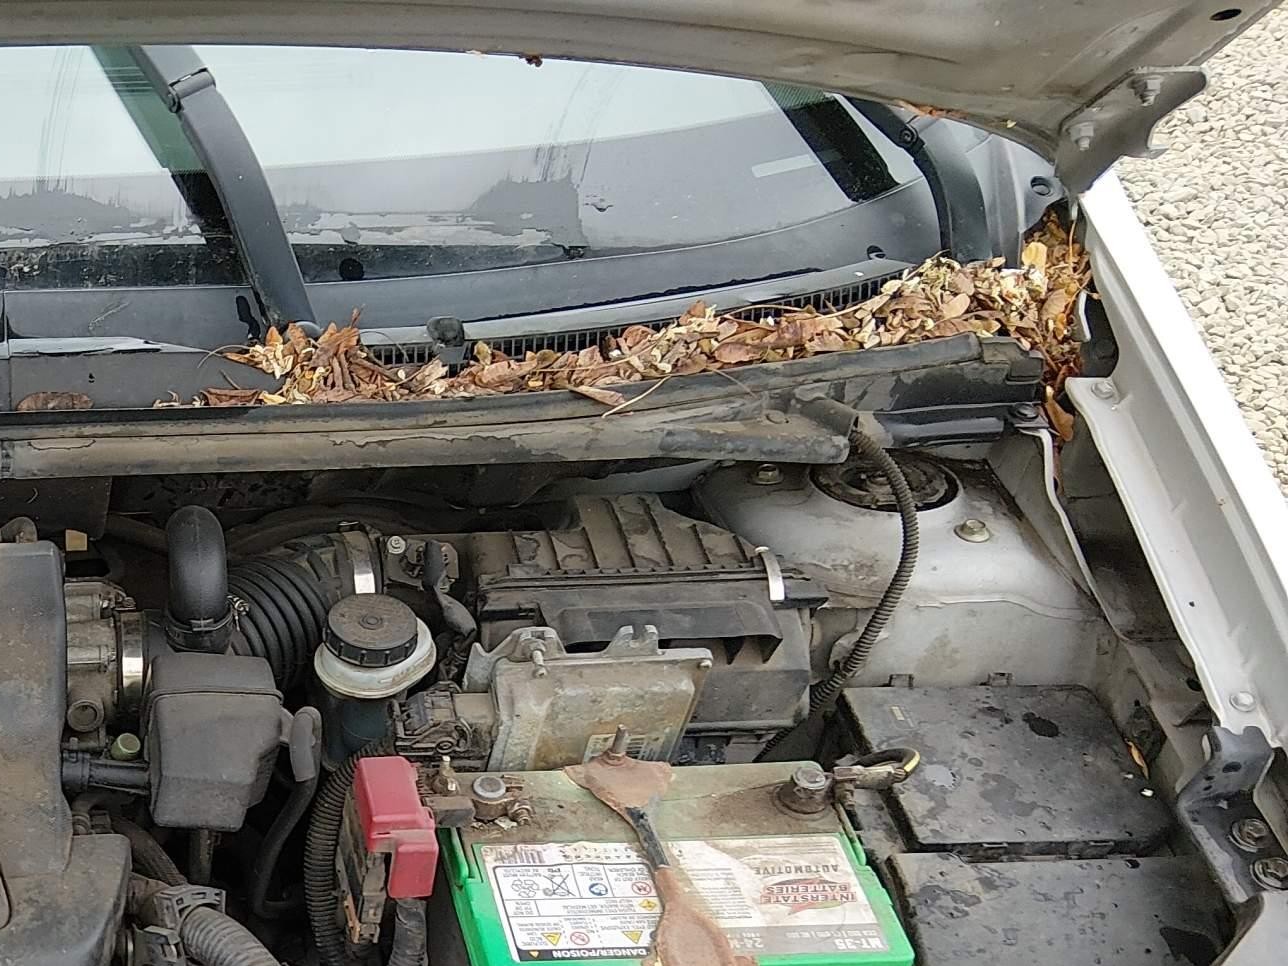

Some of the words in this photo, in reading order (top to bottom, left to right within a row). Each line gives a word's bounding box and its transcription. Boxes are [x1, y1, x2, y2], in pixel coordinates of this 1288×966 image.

[754, 864, 839, 876] AUTOMOTIVE
[766, 884, 848, 894] BATTERIES
[762, 893, 855, 904] INTERSTATE
[834, 938, 883, 950] MT-35
[552, 948, 648, 958] DANGER/POISON
